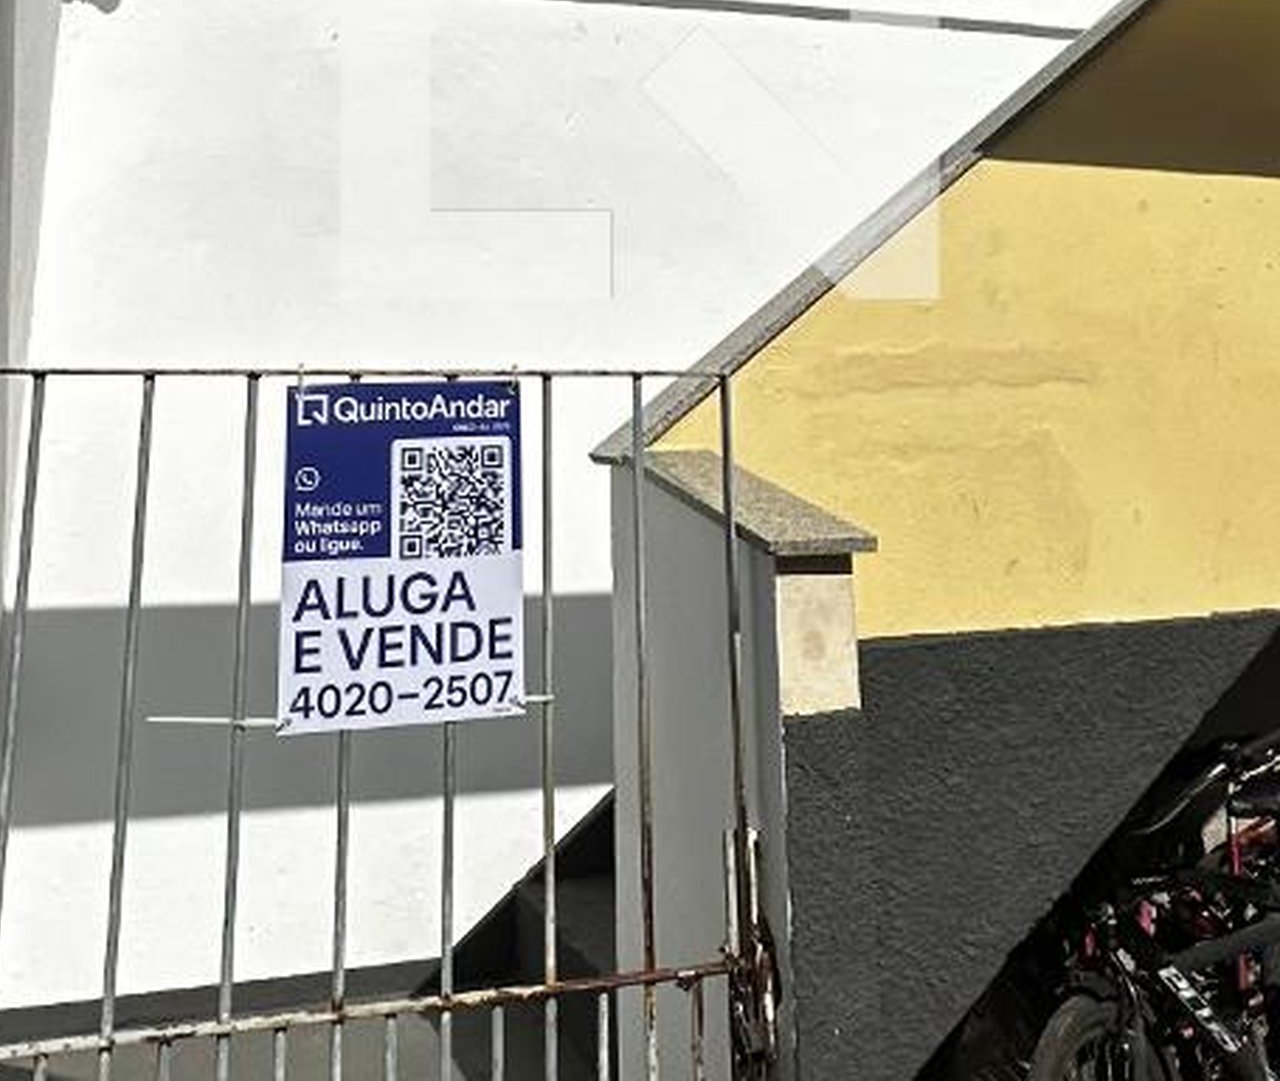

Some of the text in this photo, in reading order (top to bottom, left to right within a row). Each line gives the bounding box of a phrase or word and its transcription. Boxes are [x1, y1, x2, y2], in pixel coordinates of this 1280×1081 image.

[333, 394, 510, 423] QuintoAndar
[295, 502, 382, 517] Mande um
[295, 520, 381, 535] Whatsapp
[295, 540, 316, 553] ou
[292, 571, 476, 622] ALUGA
[294, 617, 513, 674] E VENDE
[289, 671, 513, 719] 4020-2507
